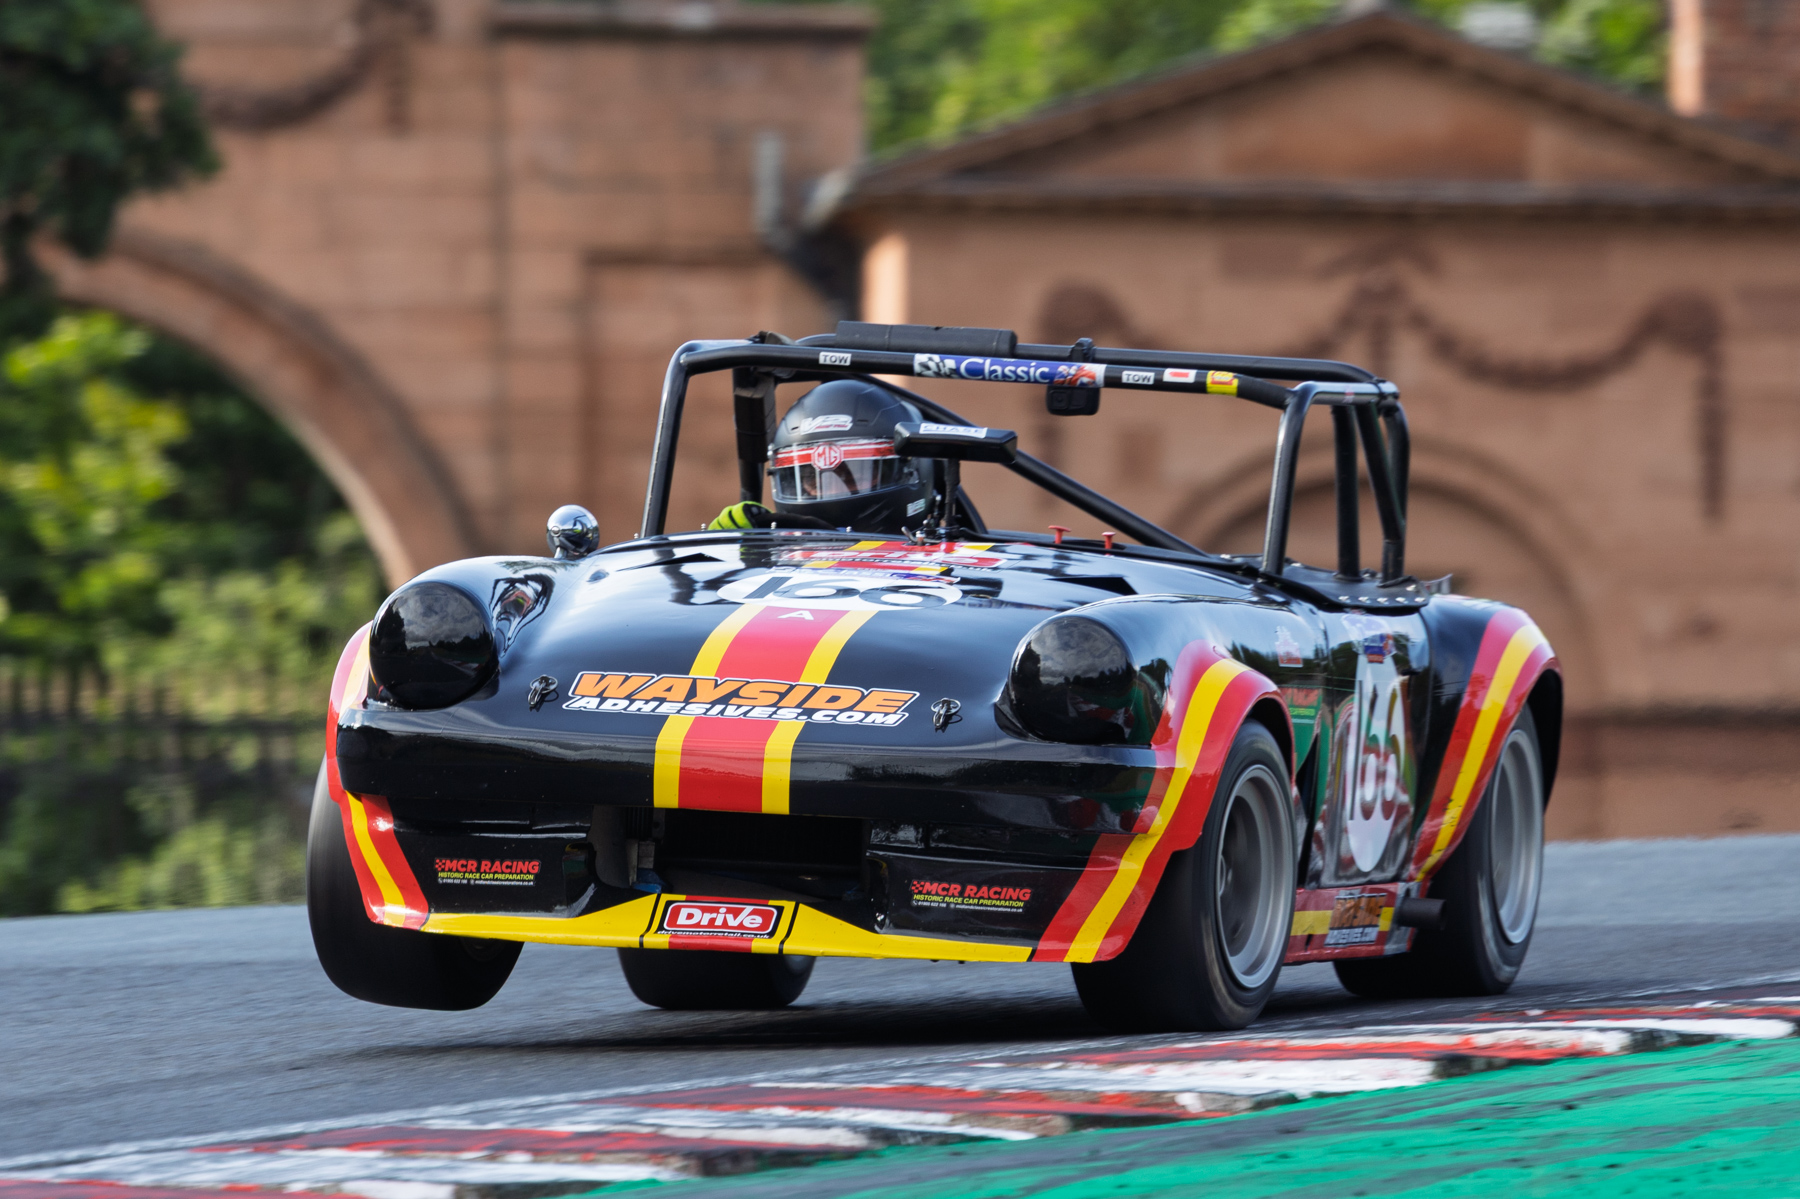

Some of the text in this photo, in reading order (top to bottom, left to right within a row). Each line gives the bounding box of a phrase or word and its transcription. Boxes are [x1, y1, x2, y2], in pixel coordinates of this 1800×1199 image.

[822, 354, 849, 364] TOW
[959, 358, 1050, 383] Classic
[1125, 373, 1152, 384] TOW
[815, 449, 840, 465] MG
[743, 576, 949, 609] 166
[777, 610, 814, 620] A
[573, 673, 916, 714] WAYSIDE
[576, 697, 908, 725] ADHESIVES.COM
[1349, 679, 1404, 821] 166
[444, 859, 540, 874] MCR RACING
[922, 881, 1032, 900] MCR RACING
[913, 894, 944, 902] HISTORIC
[979, 899, 1024, 907] PREPARATION
[657, 930, 770, 939] drivemotorretail.co.uk
